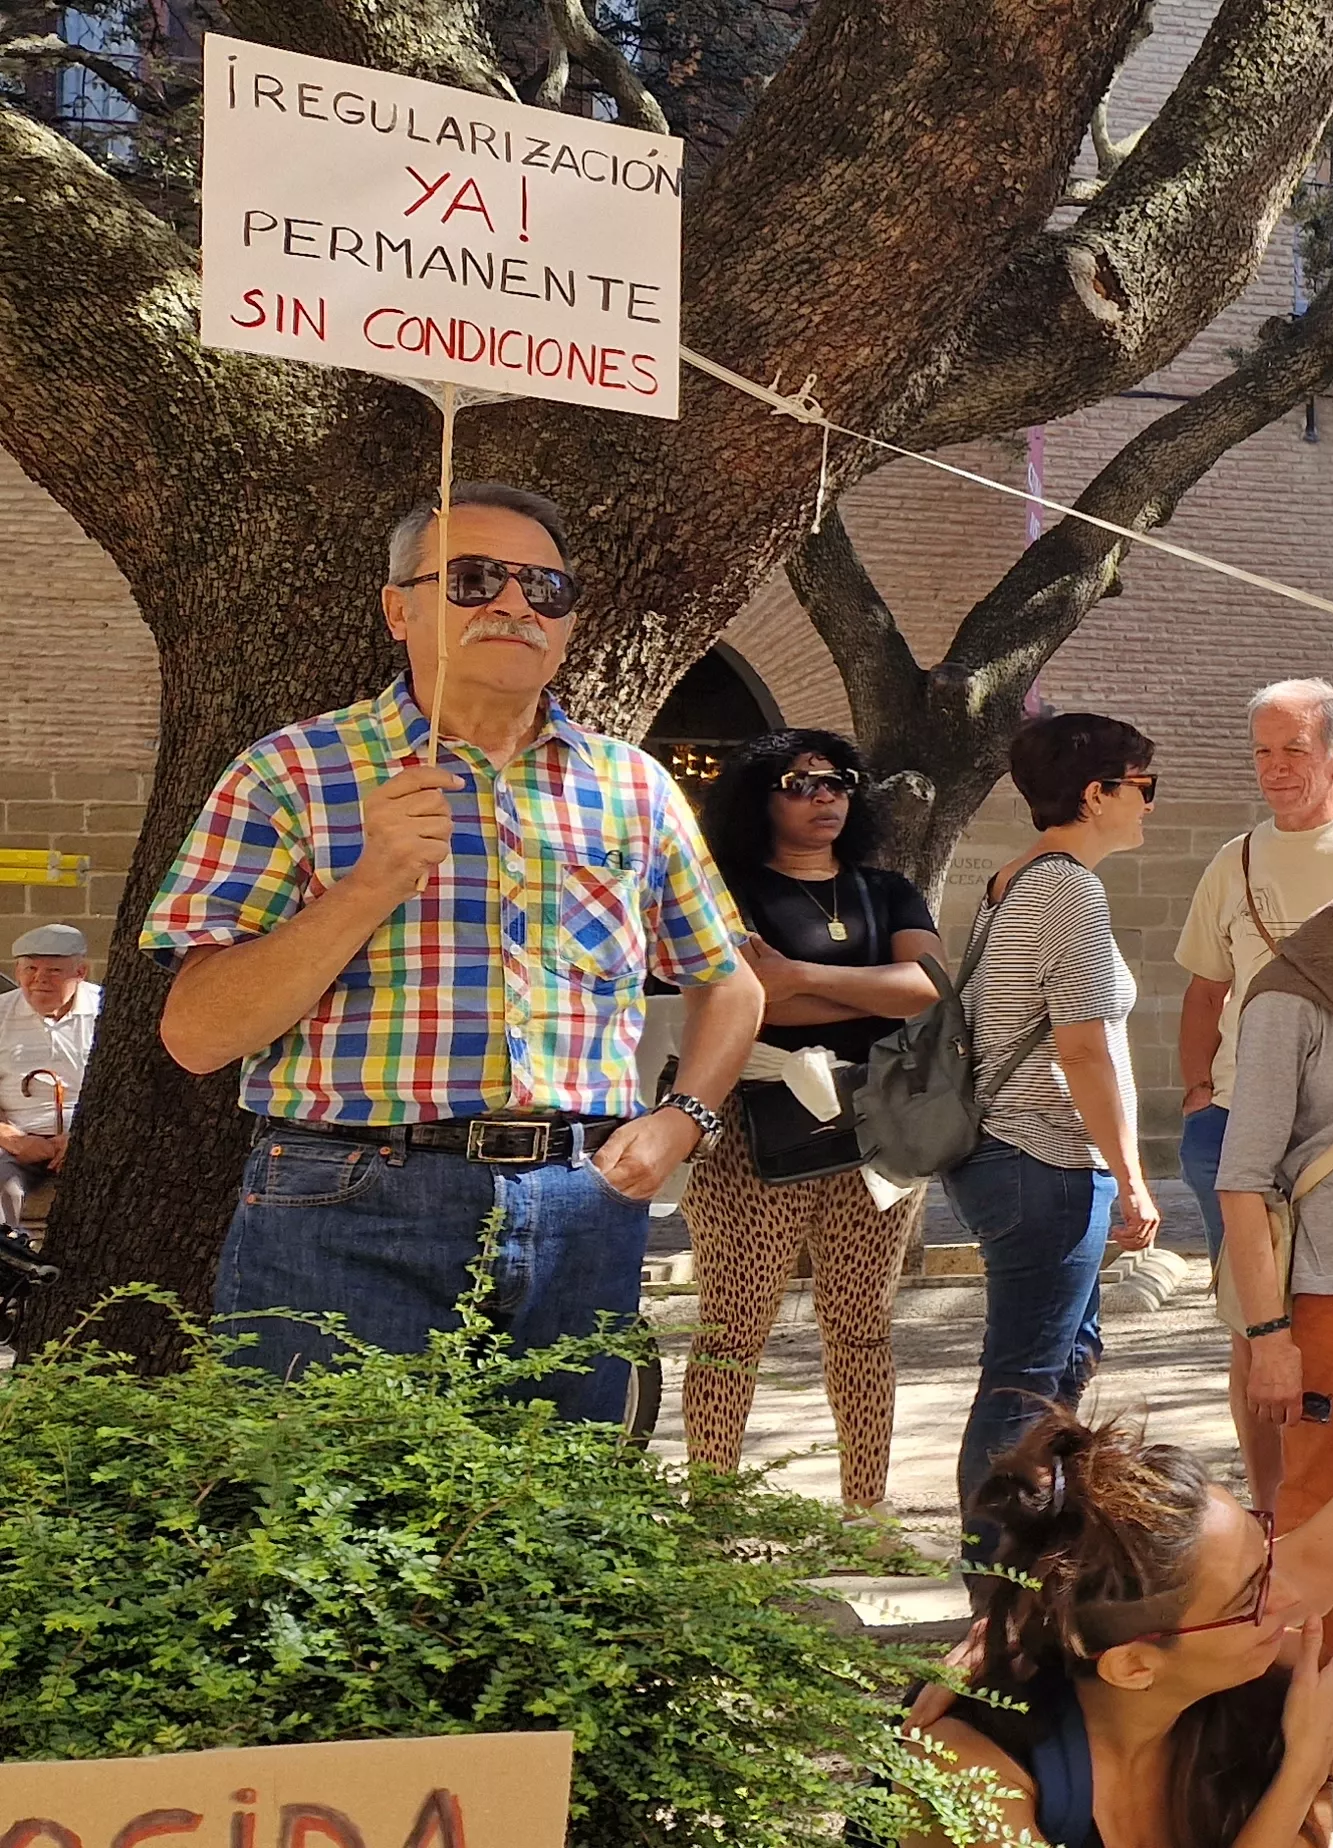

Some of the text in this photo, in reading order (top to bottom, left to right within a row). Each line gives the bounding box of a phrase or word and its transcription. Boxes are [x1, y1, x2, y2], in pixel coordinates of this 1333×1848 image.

[242, 209, 662, 324] PERMANENTE
[229, 288, 660, 396] SIN CONDICIONES
